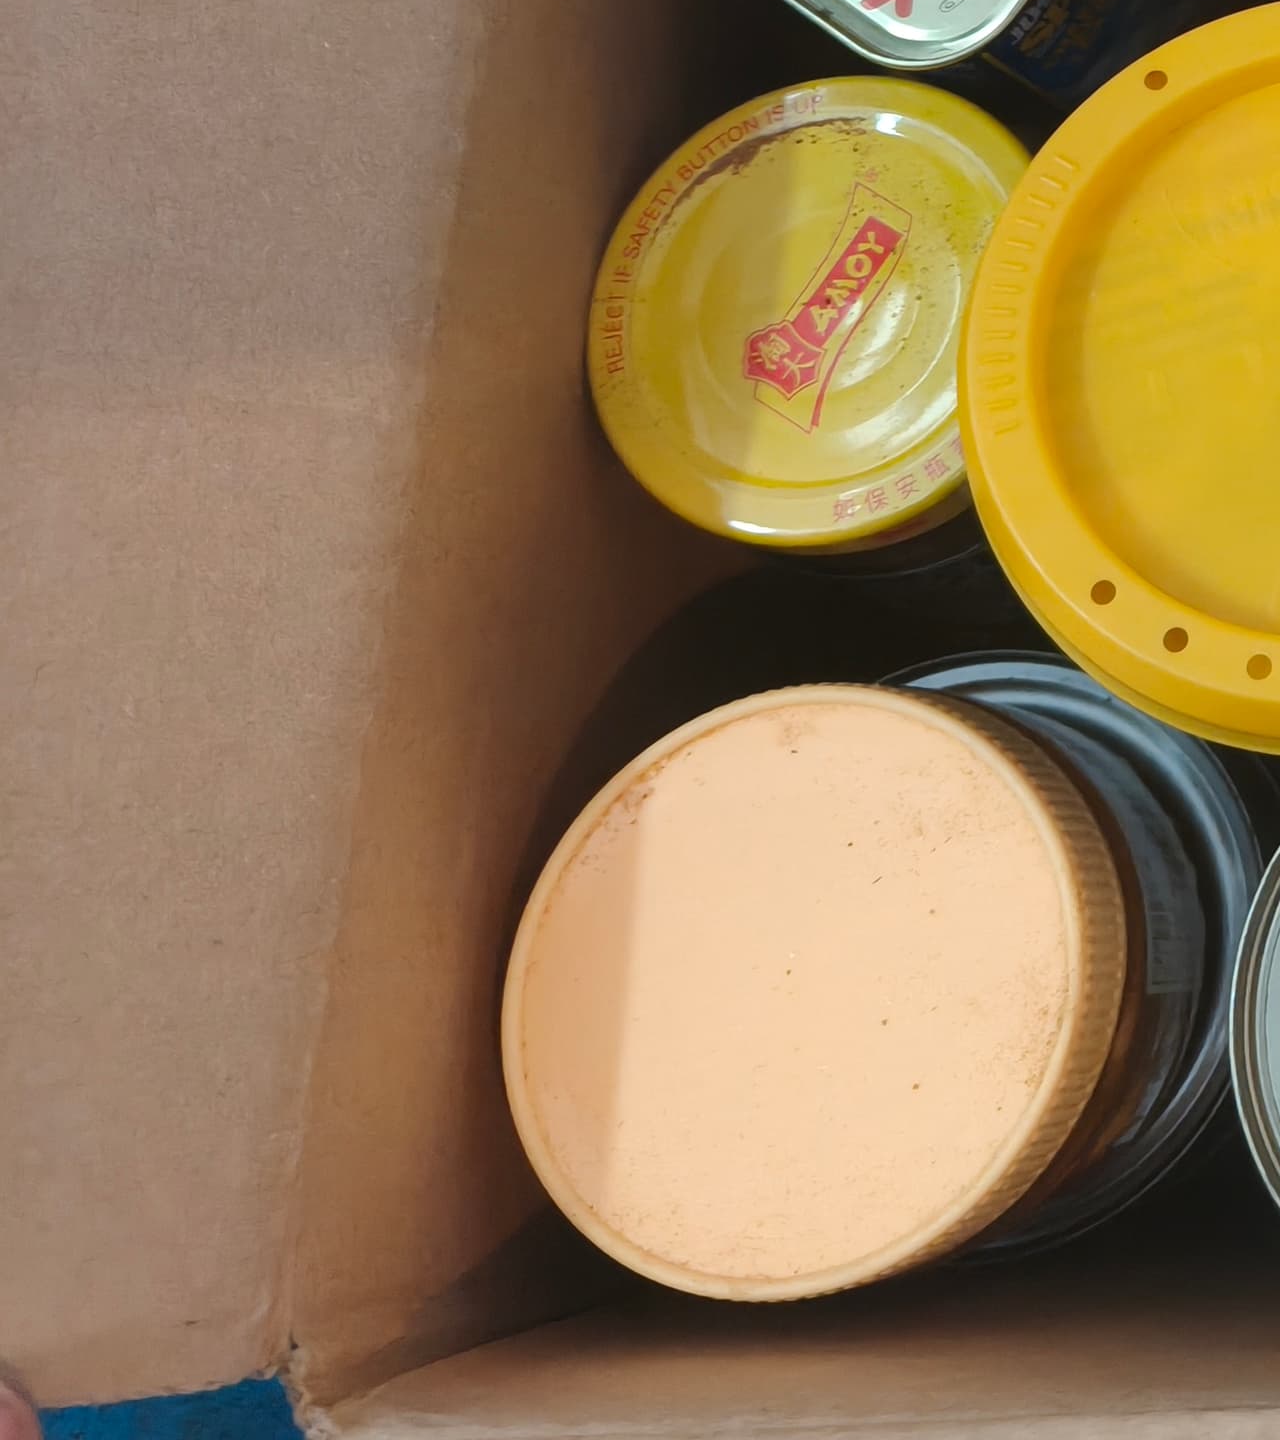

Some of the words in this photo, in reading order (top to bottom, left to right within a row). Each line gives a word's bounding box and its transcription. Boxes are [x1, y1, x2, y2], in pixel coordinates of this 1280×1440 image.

[766, 104, 785, 124] IS
[795, 95, 824, 114] UP
[676, 119, 760, 182] BUTTON
[623, 180, 677, 261] SAFETY
[611, 264, 632, 284] IF
[809, 230, 885, 336] AMOY
[605, 295, 624, 375] REJECT
